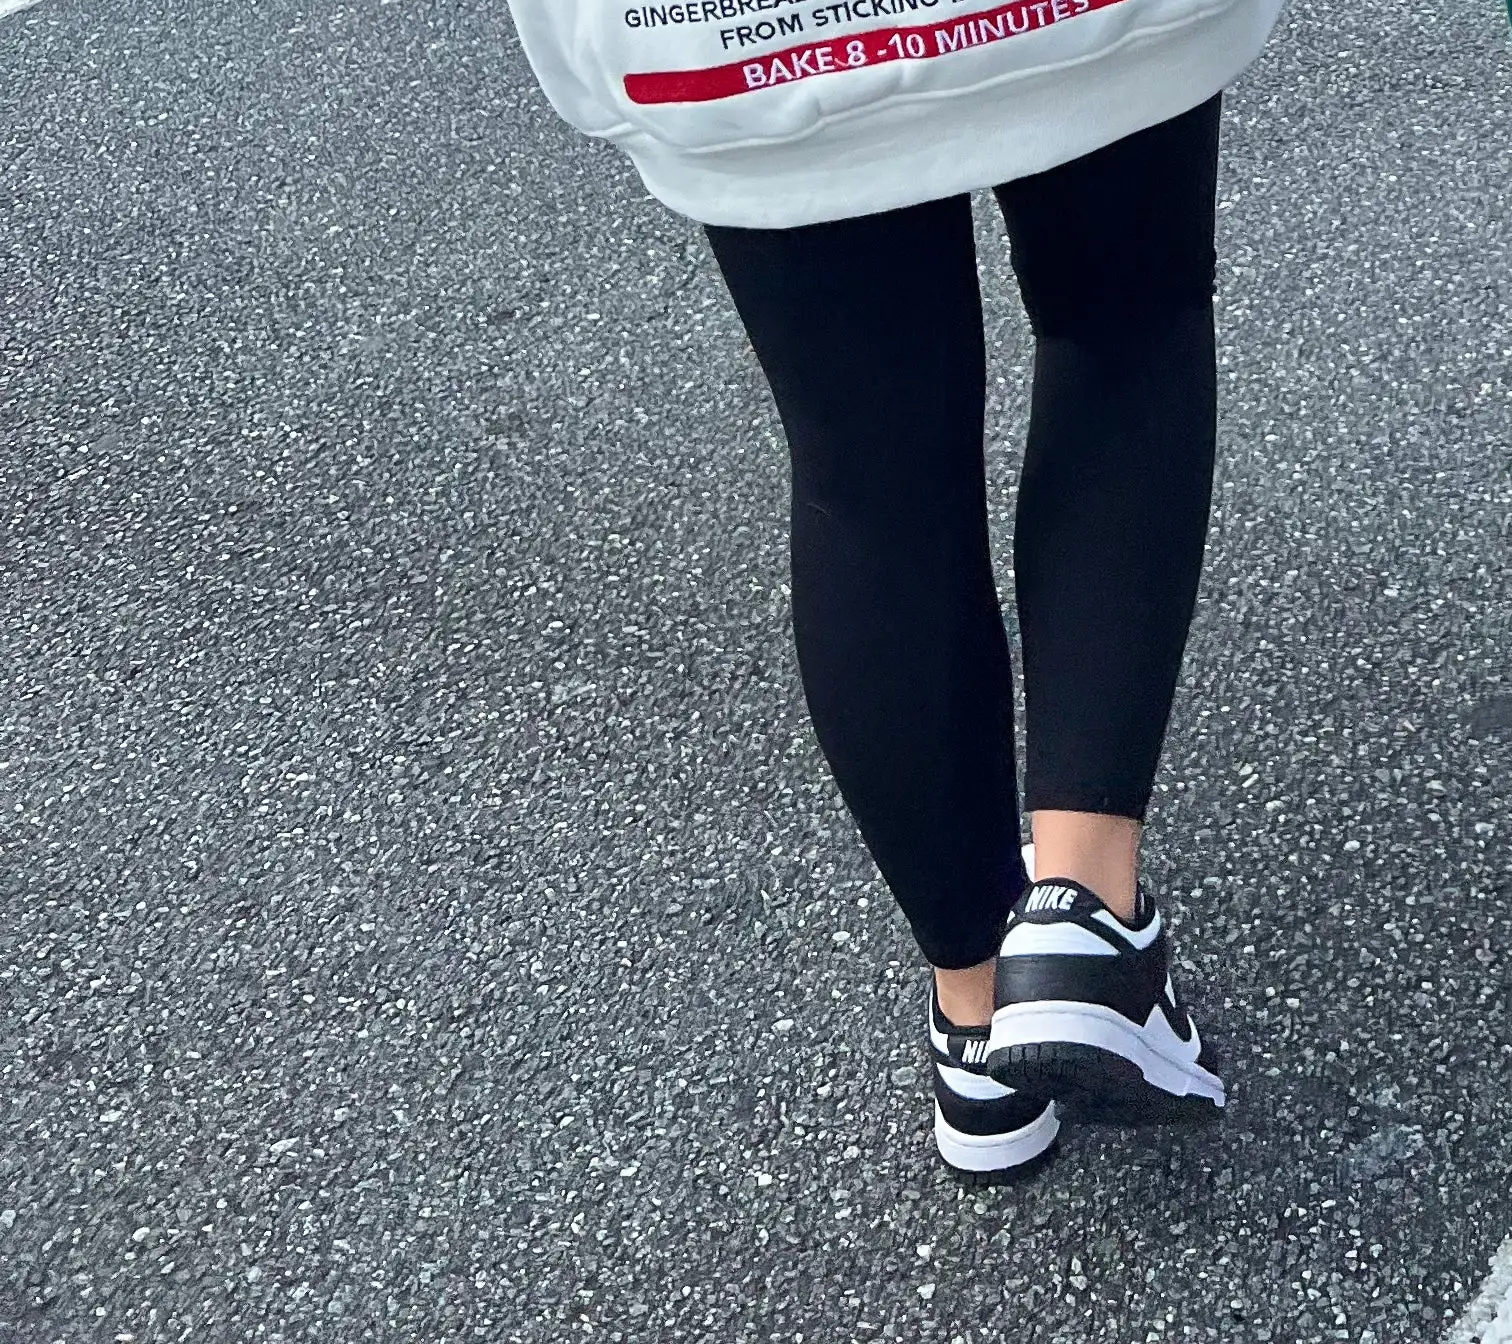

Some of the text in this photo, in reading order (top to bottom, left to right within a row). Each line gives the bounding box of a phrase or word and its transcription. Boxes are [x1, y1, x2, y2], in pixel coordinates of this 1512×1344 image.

[719, 13, 805, 50] FROM
[742, 46, 836, 89] BAKE
[1024, 884, 1079, 913] NIKE
[961, 1039, 991, 1064] NI
